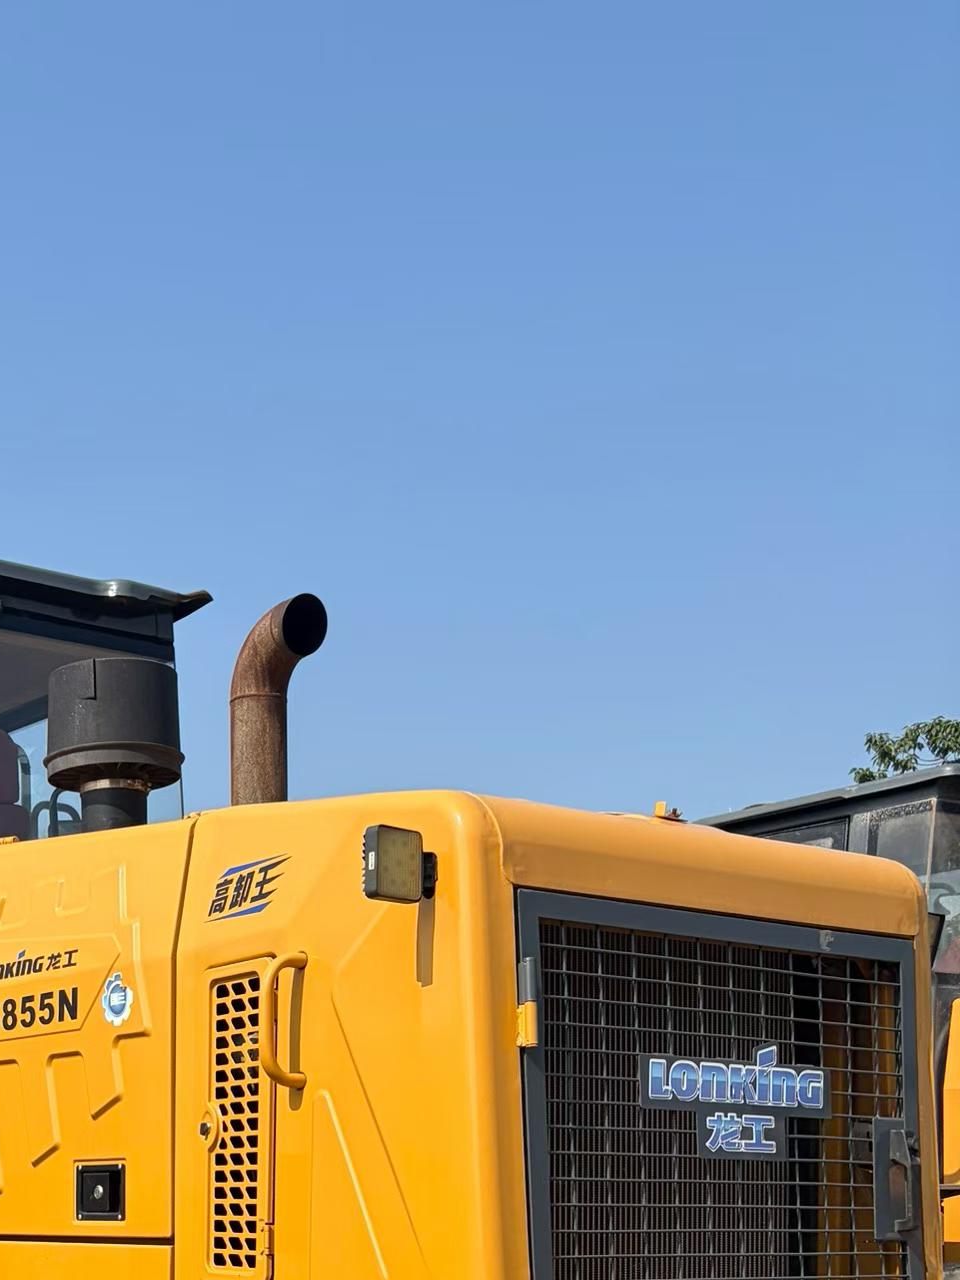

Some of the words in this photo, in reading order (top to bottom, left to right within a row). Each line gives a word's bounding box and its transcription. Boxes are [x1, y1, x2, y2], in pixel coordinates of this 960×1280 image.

[208, 856, 292, 917] 高卸王
[46, 949, 78, 971] 龙工
[705, 1112, 777, 1153] 龙工
